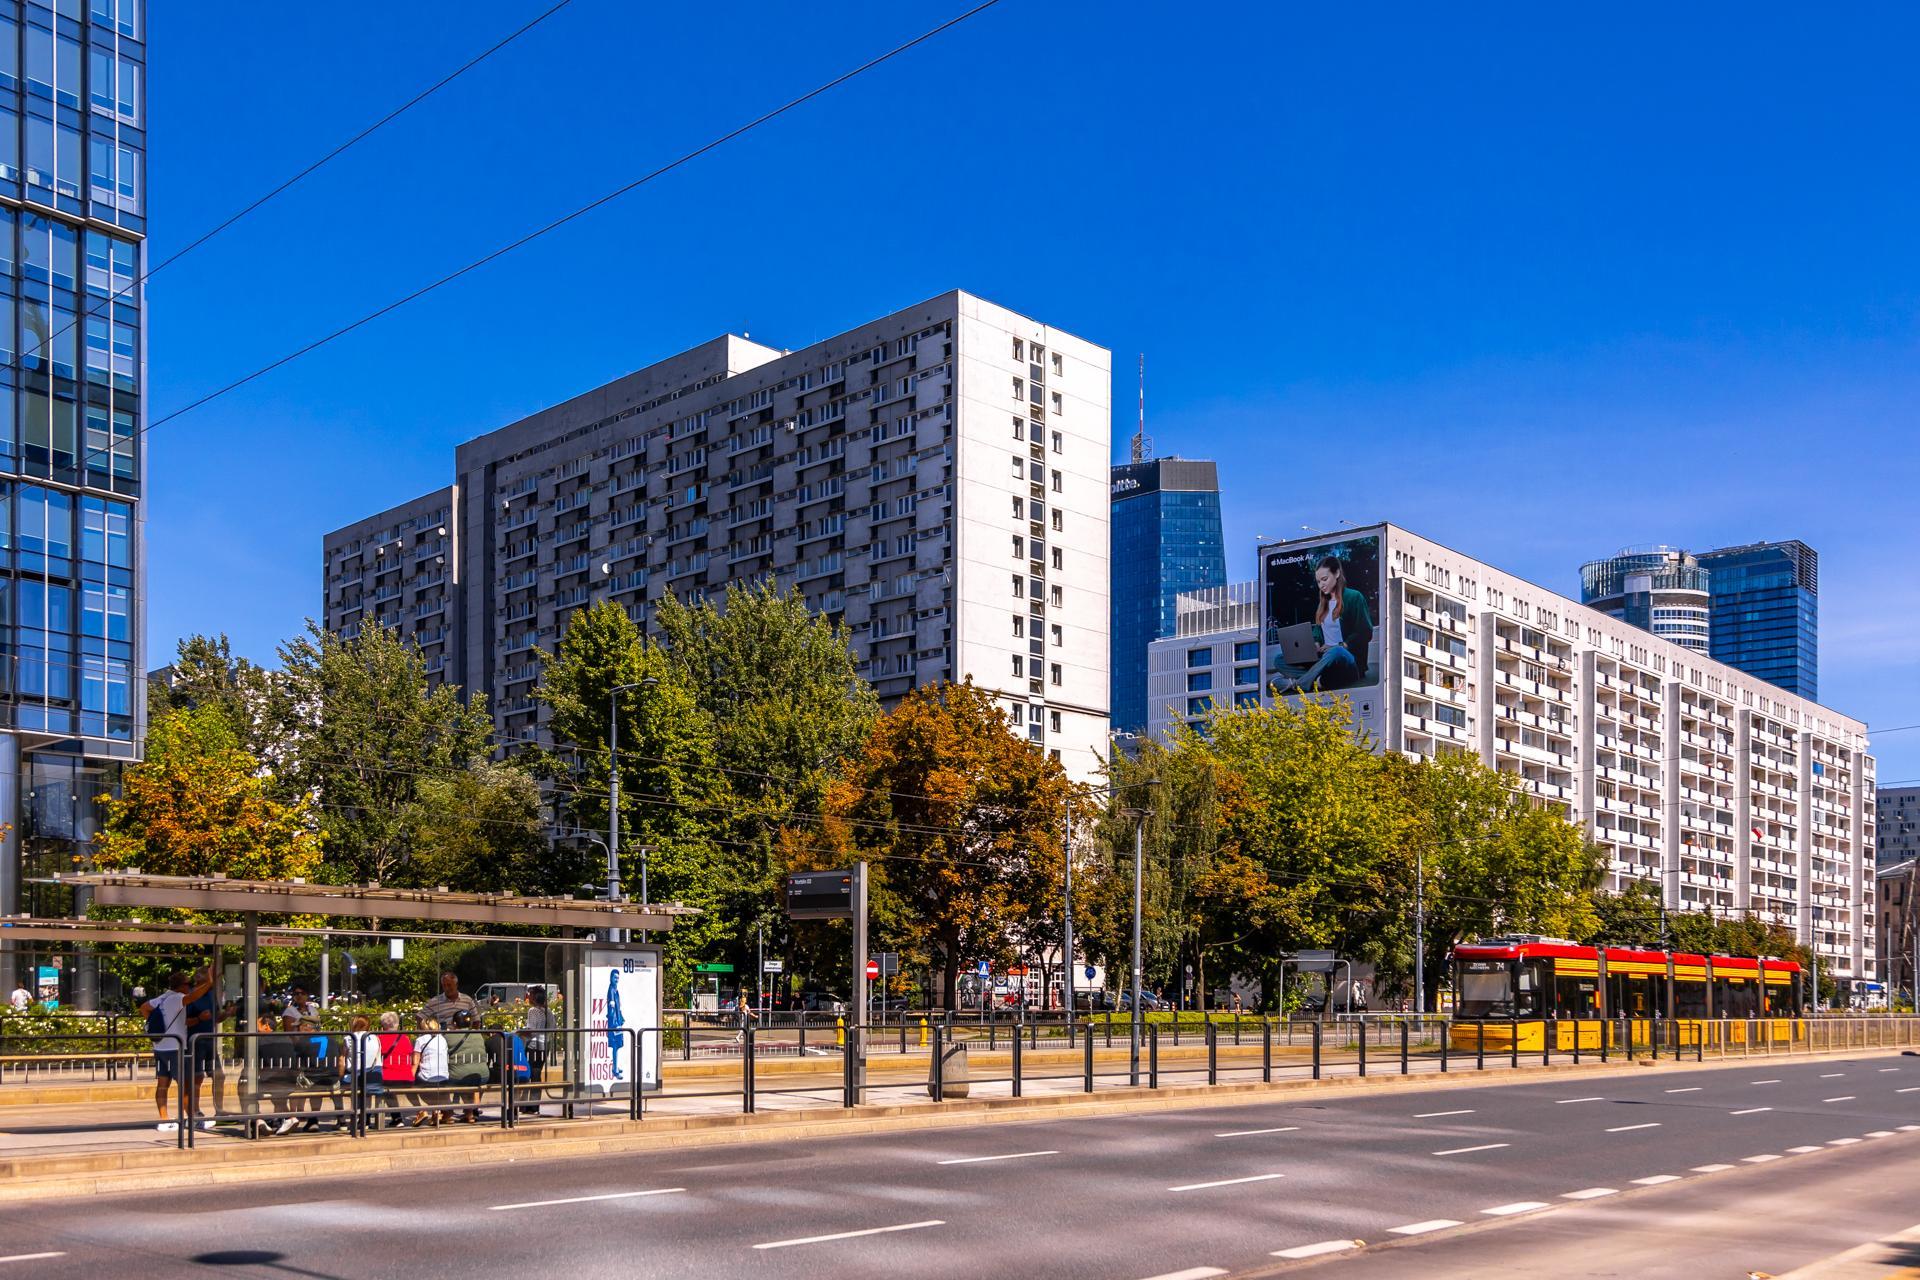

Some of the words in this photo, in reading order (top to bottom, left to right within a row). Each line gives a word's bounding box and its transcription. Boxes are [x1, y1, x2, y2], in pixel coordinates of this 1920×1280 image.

[1276, 555, 1304, 566] MacBook
[1305, 553, 1314, 561] Air
[623, 958, 634, 973] 80
[1495, 962, 1505, 970] 74
[310, 1036, 328, 1059] 7
